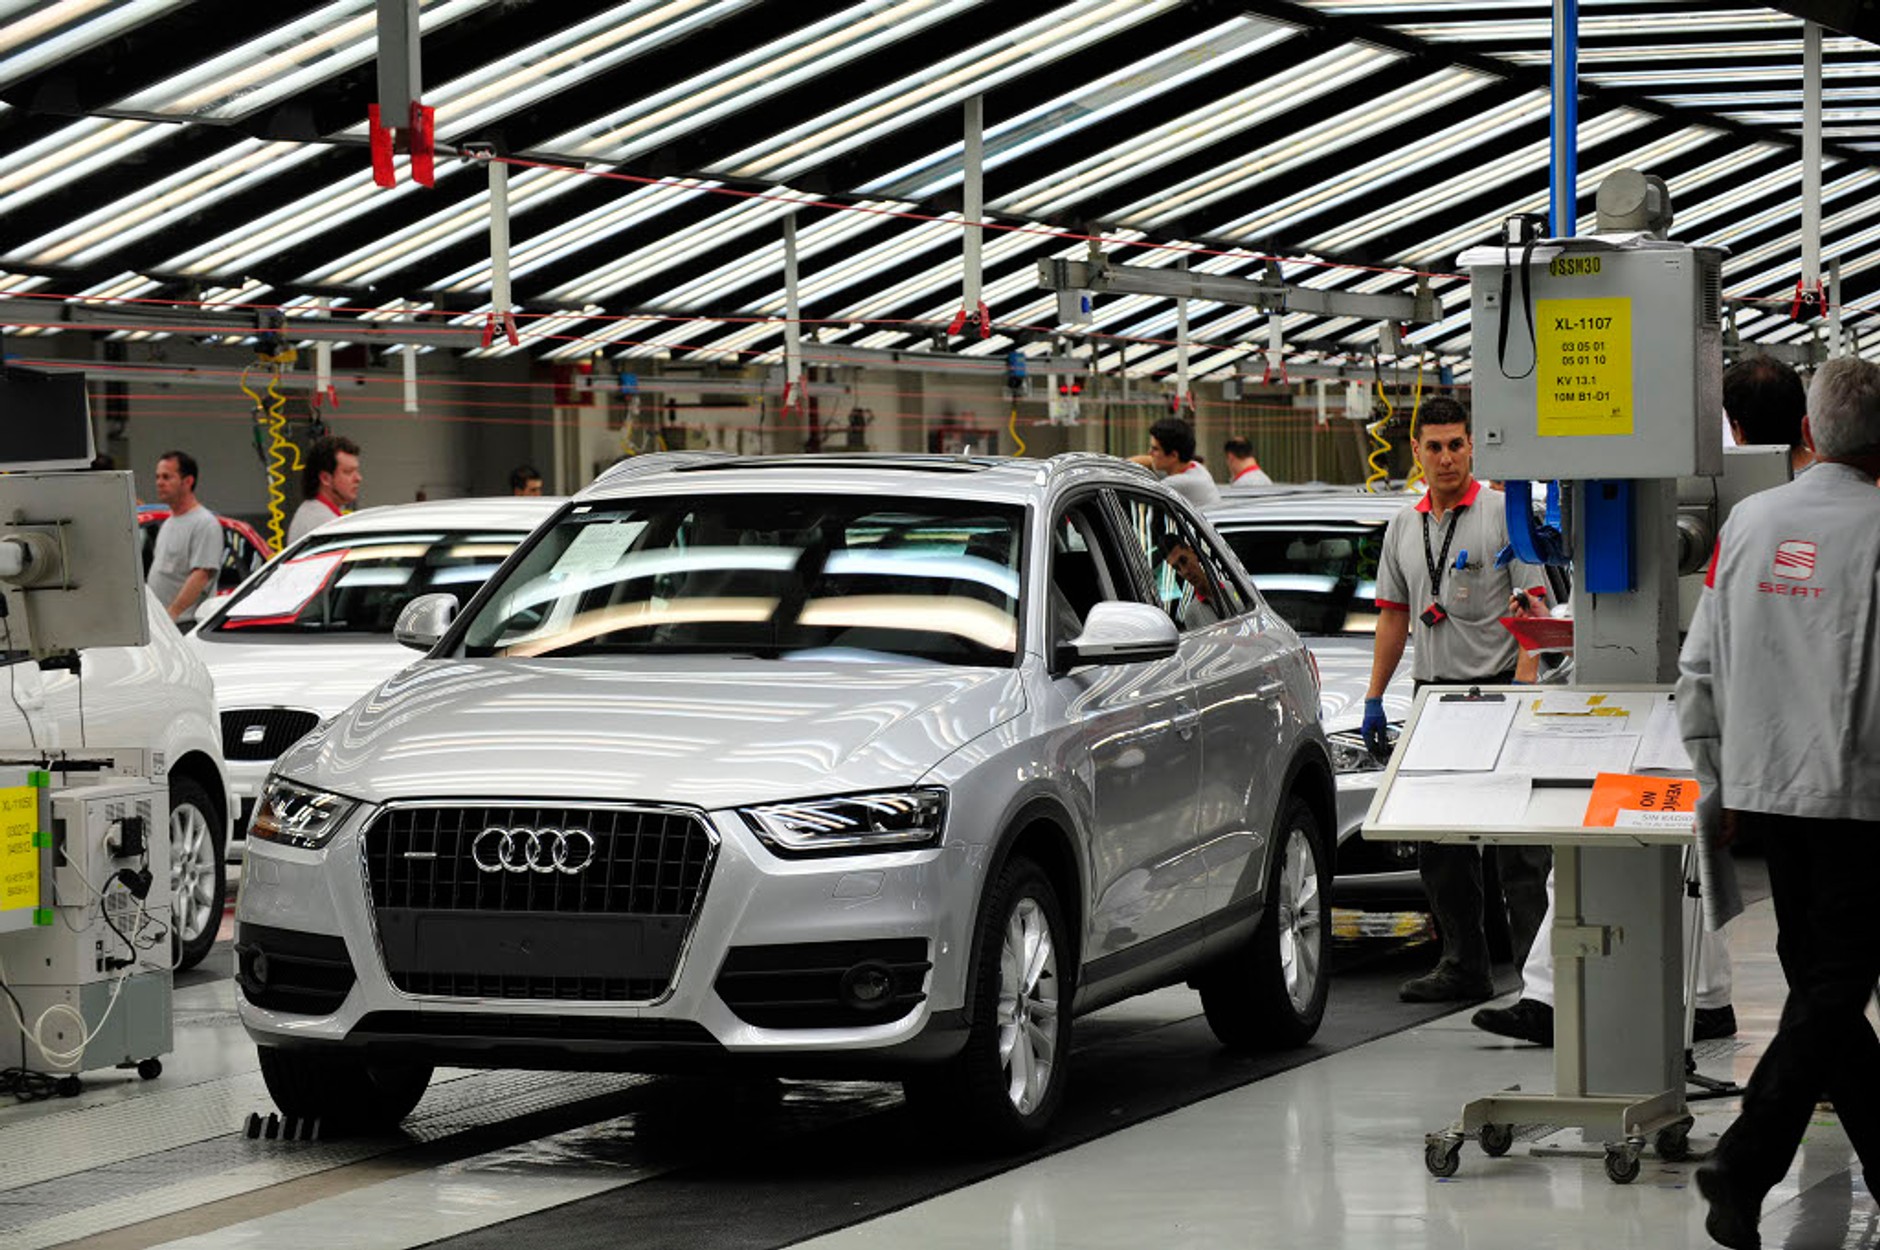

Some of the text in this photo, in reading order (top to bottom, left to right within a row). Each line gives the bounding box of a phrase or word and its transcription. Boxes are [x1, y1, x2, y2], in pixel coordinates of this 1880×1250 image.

[1554, 317, 1613, 330] XL-1107
[1562, 341, 1605, 352] 03 05 01
[1562, 354, 1606, 366] 05 01 10
[1556, 376, 1597, 386] KV 13.1
[1554, 391, 1610, 402] 10M B1-D1
[1757, 581, 1825, 598] SEAT
